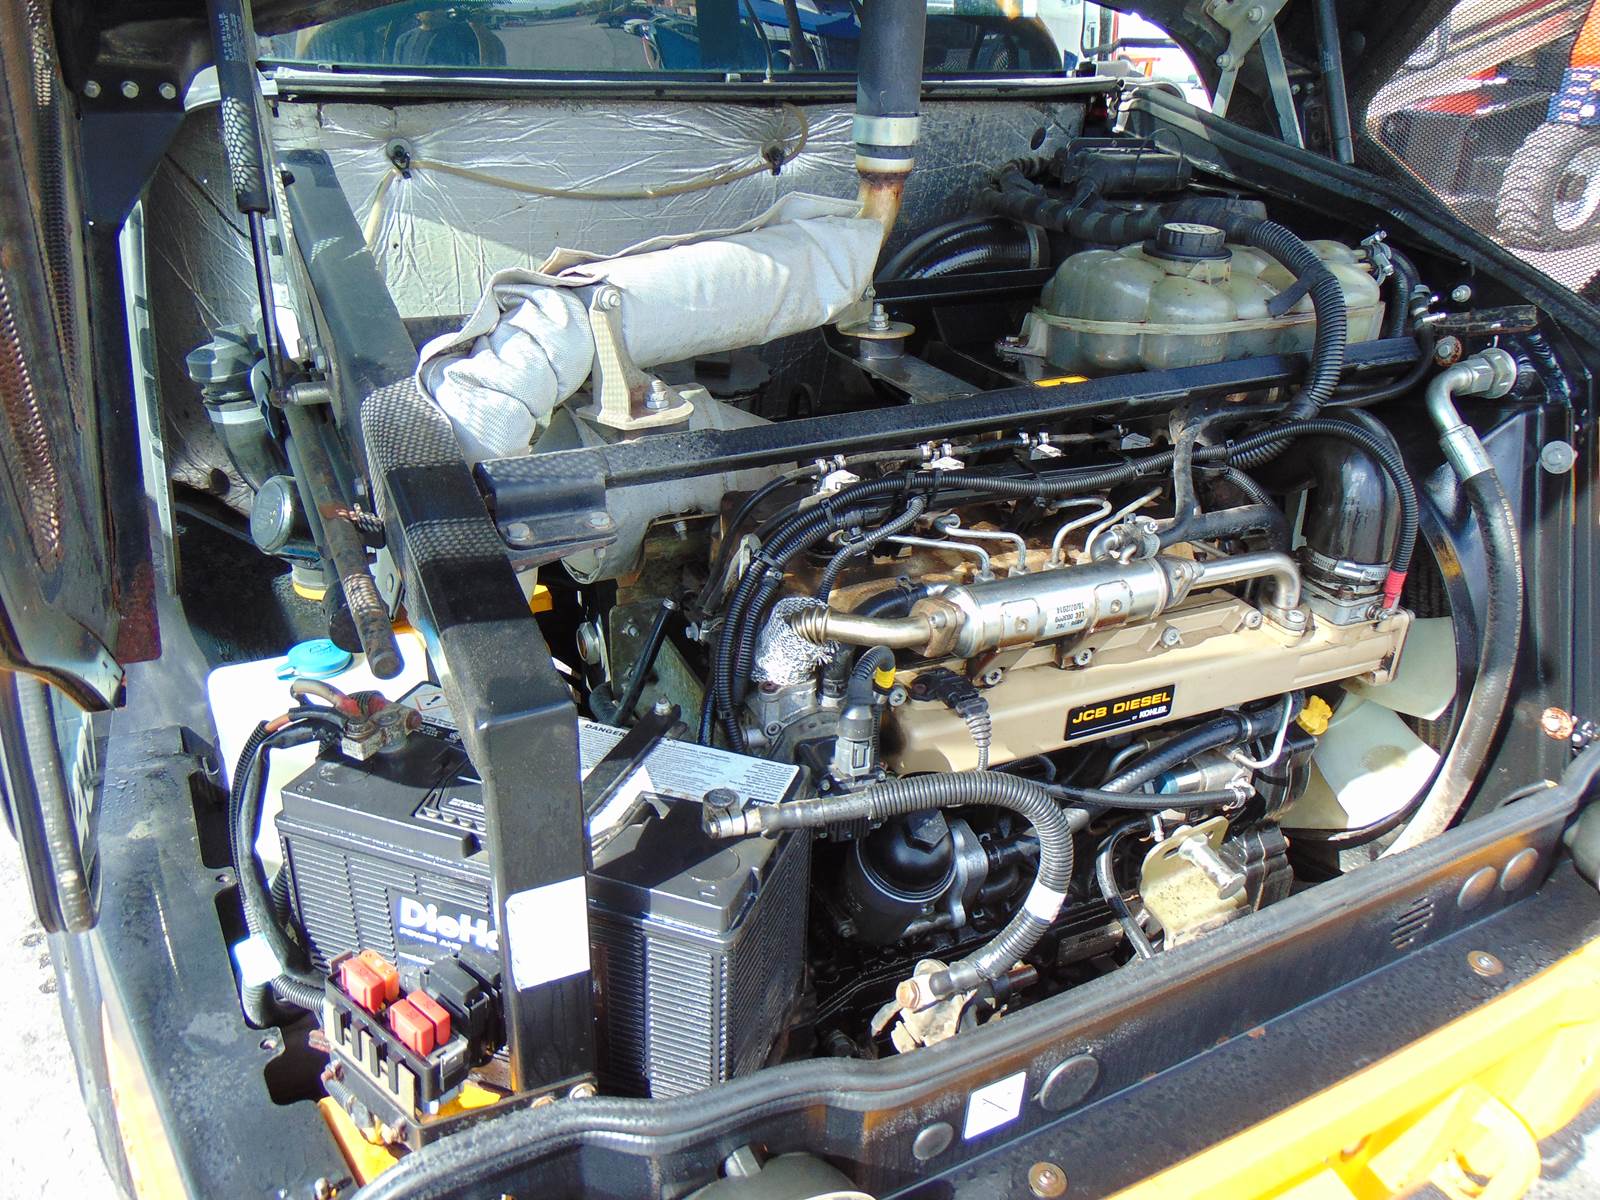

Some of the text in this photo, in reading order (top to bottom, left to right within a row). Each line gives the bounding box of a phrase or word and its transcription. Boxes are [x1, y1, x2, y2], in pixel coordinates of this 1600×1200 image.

[1072, 692, 1171, 724] JCB DIESEL
[1139, 705, 1167, 719] KOHLER
[585, 723, 626, 737] DANGER
